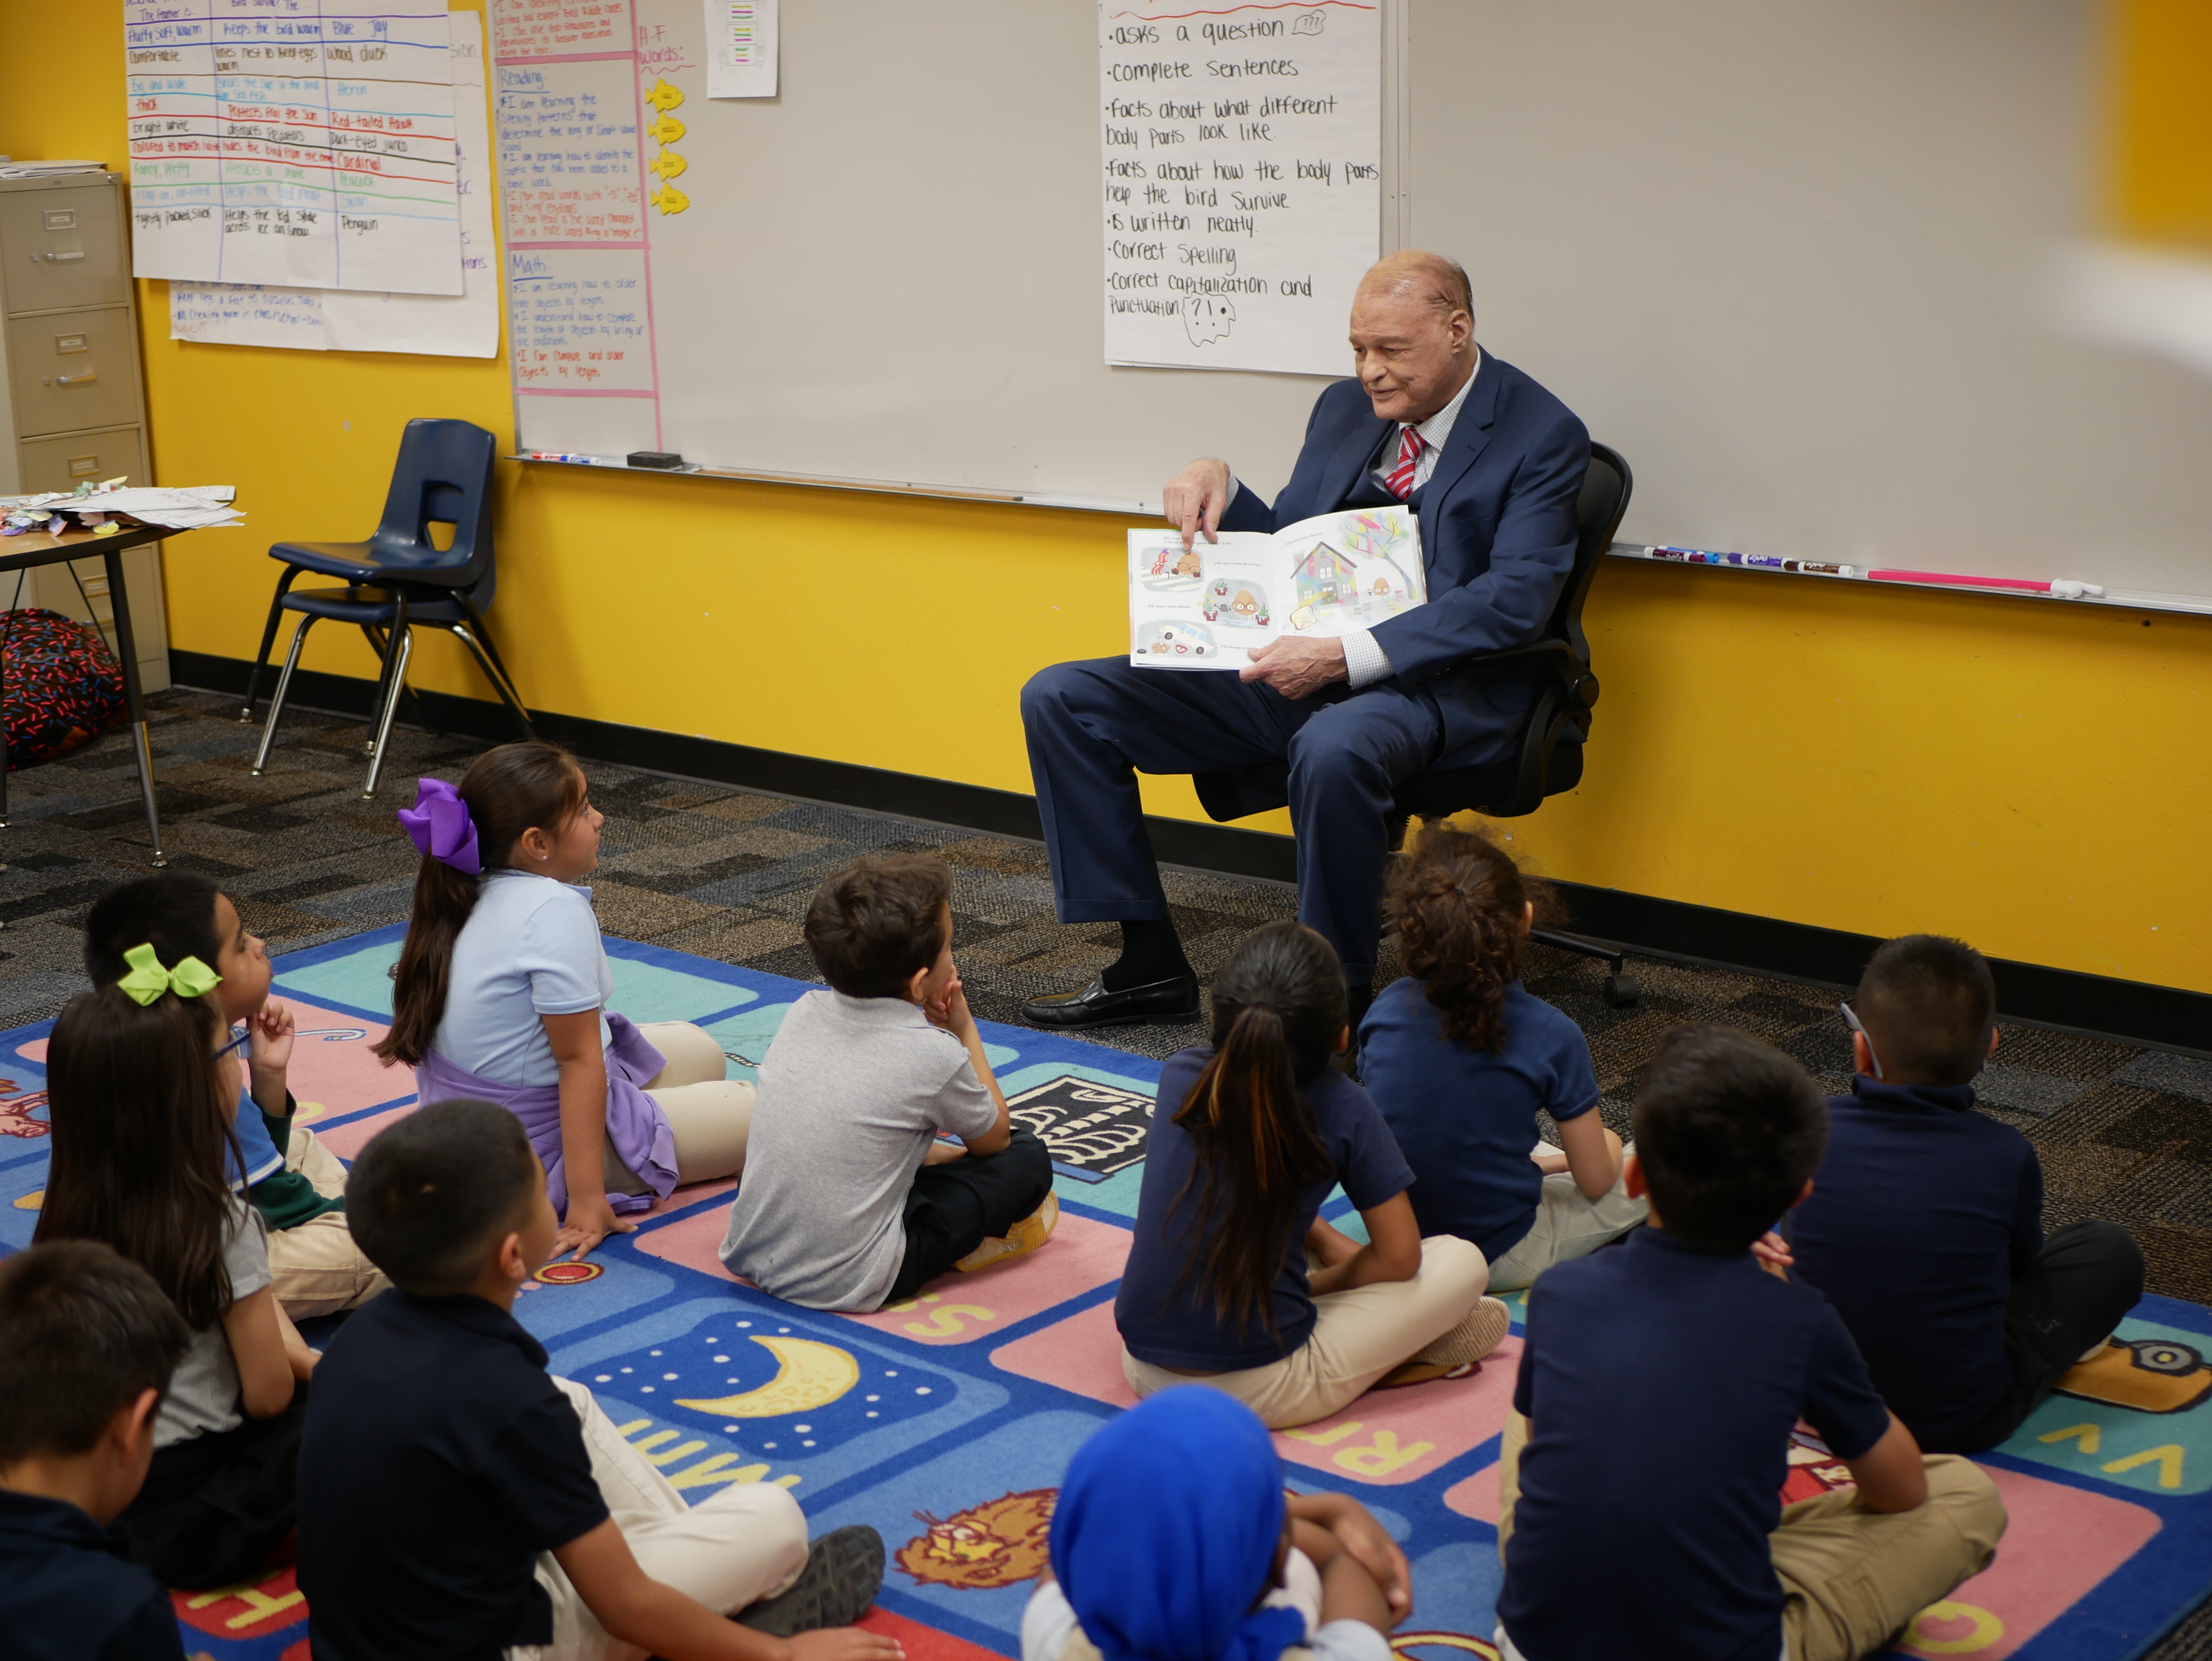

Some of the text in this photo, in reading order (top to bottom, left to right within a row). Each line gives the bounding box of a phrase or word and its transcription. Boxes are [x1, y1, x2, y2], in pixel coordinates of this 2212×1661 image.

[255, 21, 269, 35] the
[276, 21, 293, 36] bird
[332, 21, 355, 35] Blue
[1116, 25, 1160, 44] asks
[1176, 25, 1192, 41] a
[1202, 18, 1284, 46] question
[149, 79, 163, 90] and
[338, 82, 368, 96] Heron
[521, 92, 598, 114] am learning the
[1159, 100, 1206, 119] about
[1214, 99, 1252, 119] what
[1260, 95, 1339, 118] different
[286, 107, 299, 119] the
[578, 110, 597, 121] that
[133, 120, 162, 137] bright
[502, 125, 594, 140] determine the long or
[1106, 123, 1138, 150] body
[1199, 123, 1229, 142] look
[247, 140, 261, 154] the
[622, 148, 634, 159] the
[338, 151, 382, 171] Cardinal
[611, 164, 620, 173] to
[1157, 161, 1204, 181] about
[1213, 159, 1244, 180] how
[1254, 160, 1284, 181] the
[1297, 158, 1331, 186] body
[1106, 181, 1132, 204] help
[1143, 183, 1171, 206] the
[1185, 185, 1219, 208] bird
[253, 209, 271, 222] the
[1111, 211, 1125, 231] is
[1130, 211, 1191, 233] written
[340, 214, 379, 236] Penguin
[548, 280, 578, 295] learning
[582, 278, 599, 289] how
[601, 279, 612, 289] to
[1280, 275, 1313, 298] and
[566, 297, 575, 310] by
[589, 349, 603, 361] and
[558, 363, 568, 378] by
